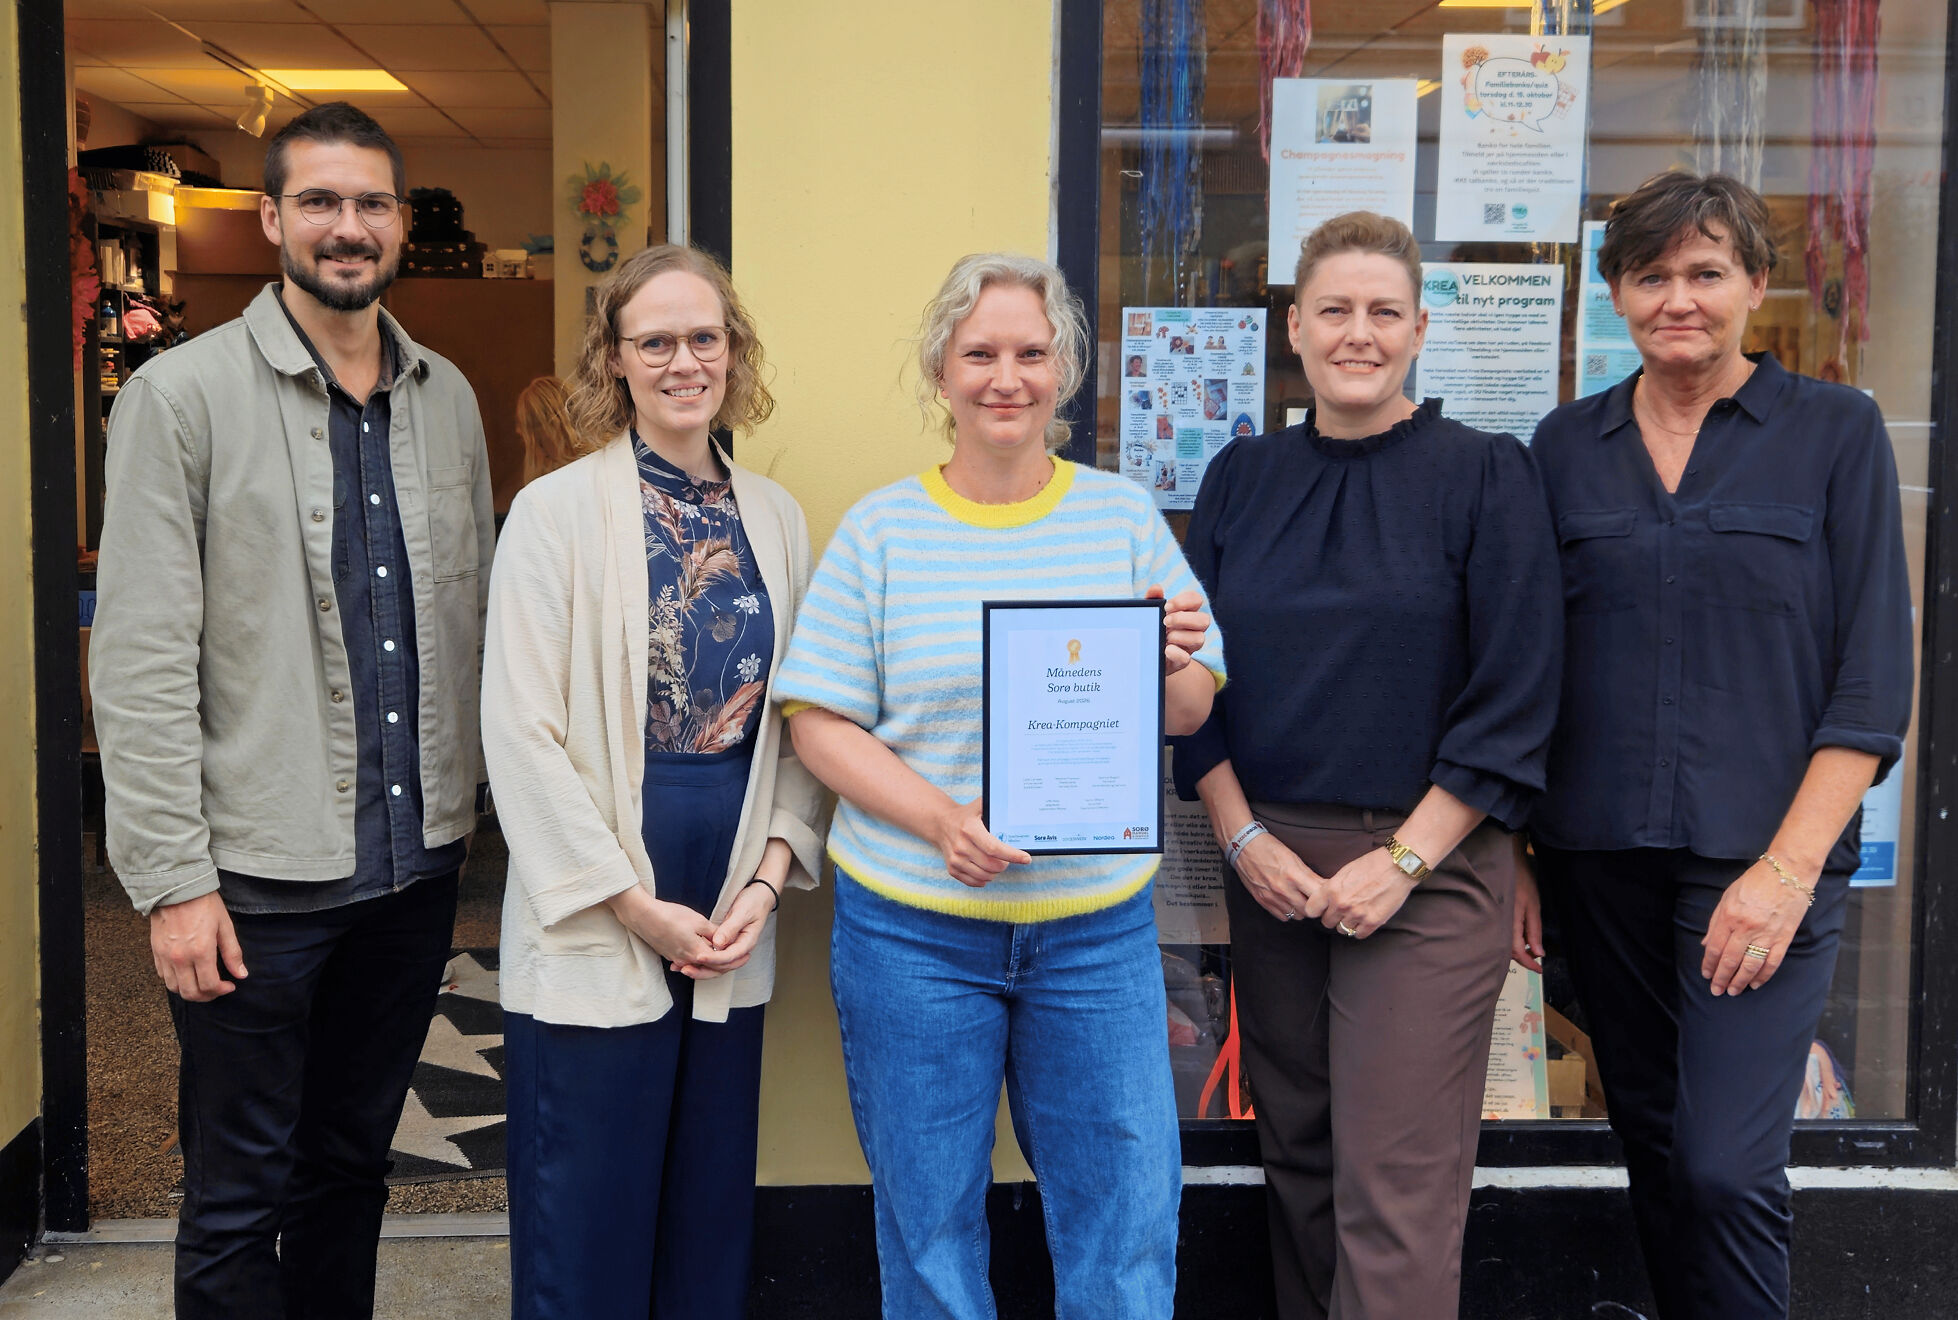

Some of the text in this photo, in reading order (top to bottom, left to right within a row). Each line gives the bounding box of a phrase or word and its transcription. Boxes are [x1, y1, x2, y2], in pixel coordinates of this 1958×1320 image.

[1281, 150, 1406, 162] Champagnesmagning
[1462, 275, 1551, 286] VELKOMMEN
[1424, 281, 1458, 291] KREA
[1456, 294, 1555, 308] til nyt program
[1046, 668, 1102, 678] Månedens
[1047, 682, 1101, 692] Sorø butik
[1166, 788, 1178, 796] KR
